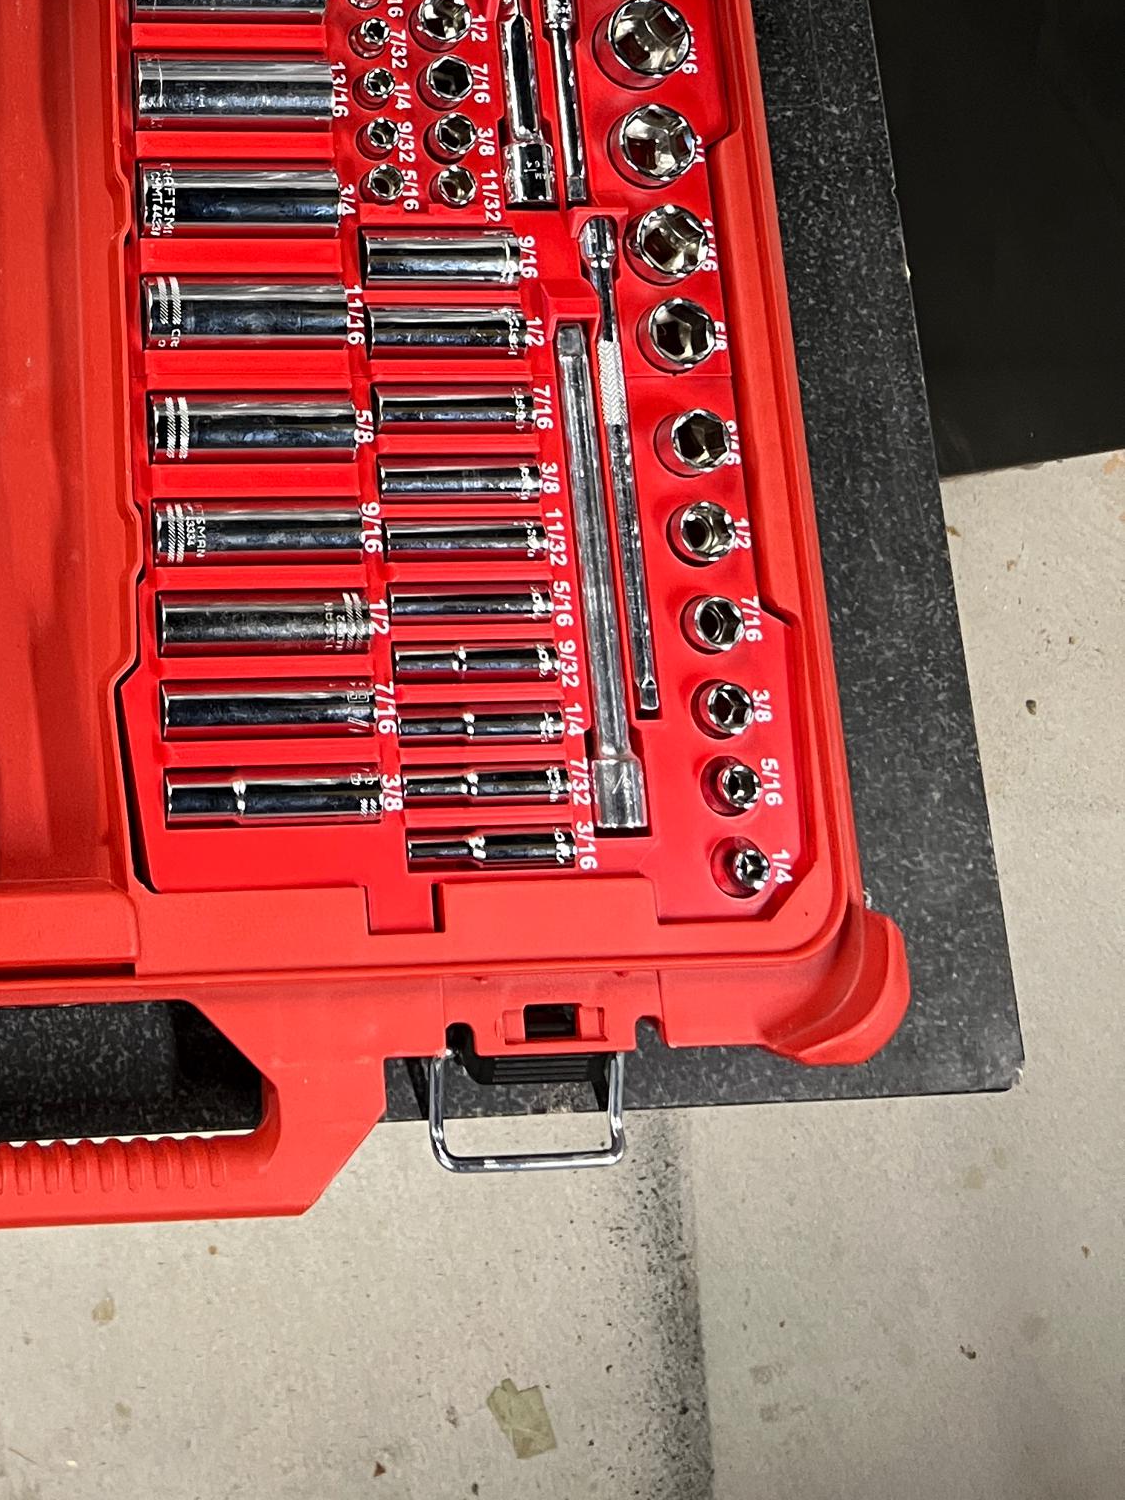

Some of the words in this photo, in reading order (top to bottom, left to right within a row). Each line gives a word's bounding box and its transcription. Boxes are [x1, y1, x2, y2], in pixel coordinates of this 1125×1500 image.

[471, 14, 488, 43] 1/2
[389, 30, 408, 69] 7/32
[331, 61, 349, 118] 13/16
[394, 82, 411, 111] 1/4
[472, 63, 490, 104] 7/16
[397, 121, 416, 163] 9/32
[477, 127, 495, 156] 3/8
[340, 184, 356, 217] 3/4
[401, 170, 420, 211] 5/16
[481, 169, 502, 223] 11/32
[518, 235, 539, 279] 9/16
[344, 284, 365, 345] 11/16
[526, 316, 545, 347] 1/2
[354, 409, 374, 444] 5/8
[532, 385, 554, 430] 7/16
[540, 462, 561, 494] 3/8
[360, 502, 383, 554] 9/16
[545, 508, 568, 567] 11/32
[734, 518, 752, 549] 1/2
[368, 599, 390, 636] 1/2
[553, 580, 574, 627] 5/16
[741, 595, 763, 643] 7/16
[558, 639, 580, 688] 9/32
[374, 681, 397, 735] 7/16
[564, 702, 585, 737] 1/4
[752, 689, 772, 723] 3/8
[380, 773, 404, 812] 3/8
[569, 757, 591, 806] 7/32
[760, 757, 783, 806] 5/16
[575, 820, 598, 870] 3/16
[772, 848, 793, 886] 1/4
